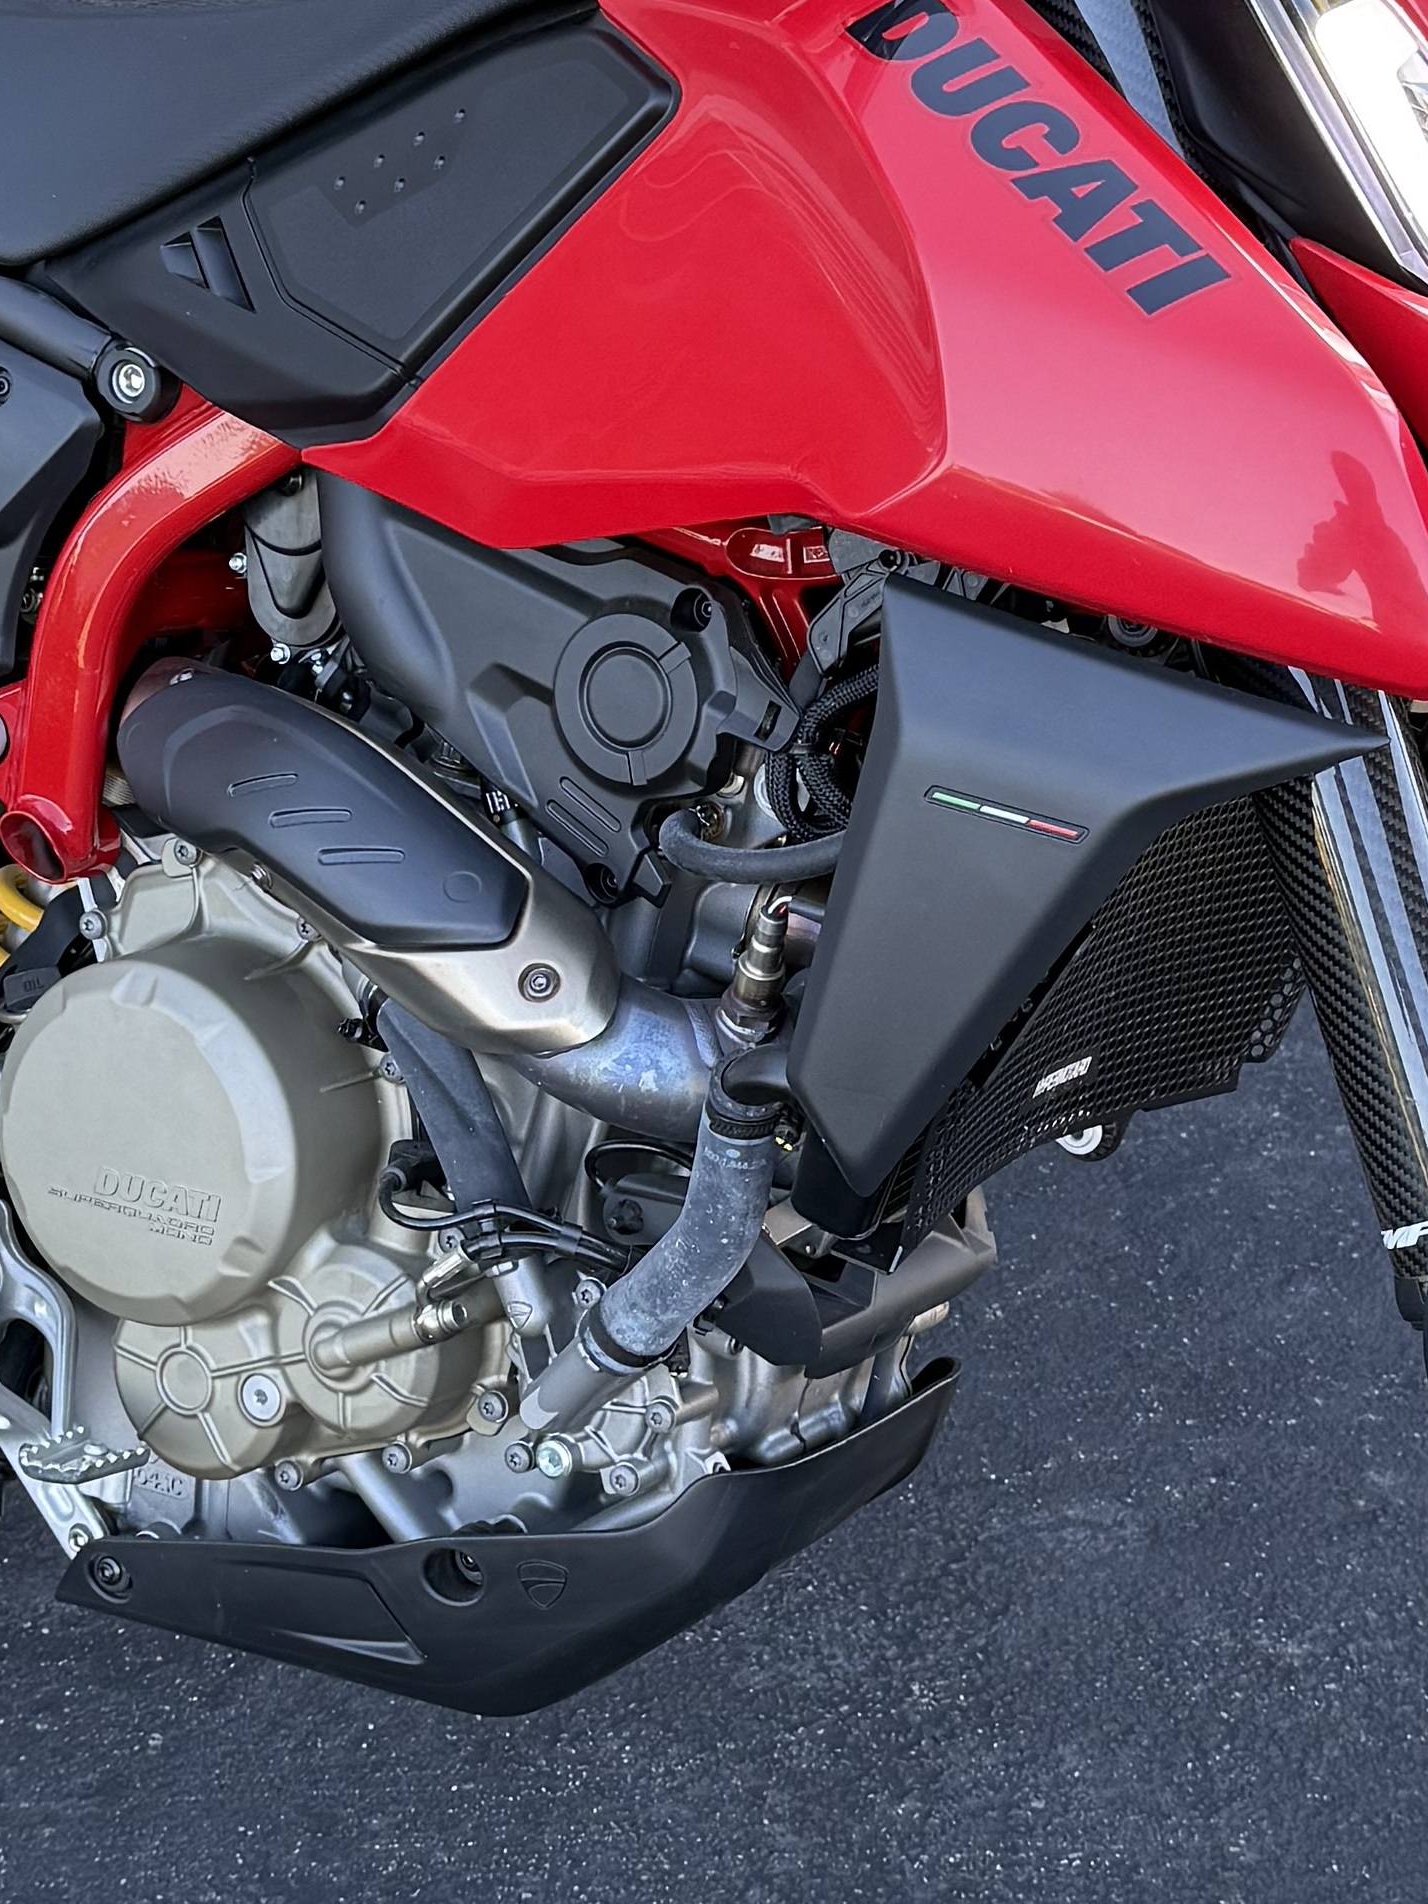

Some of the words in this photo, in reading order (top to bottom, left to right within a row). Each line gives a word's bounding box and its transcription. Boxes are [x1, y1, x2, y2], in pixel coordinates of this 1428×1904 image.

[47, 1186, 215, 1236] SUPERQUADRO
[93, 1166, 222, 1223] DUCATI
[148, 1221, 213, 1246] MONO
